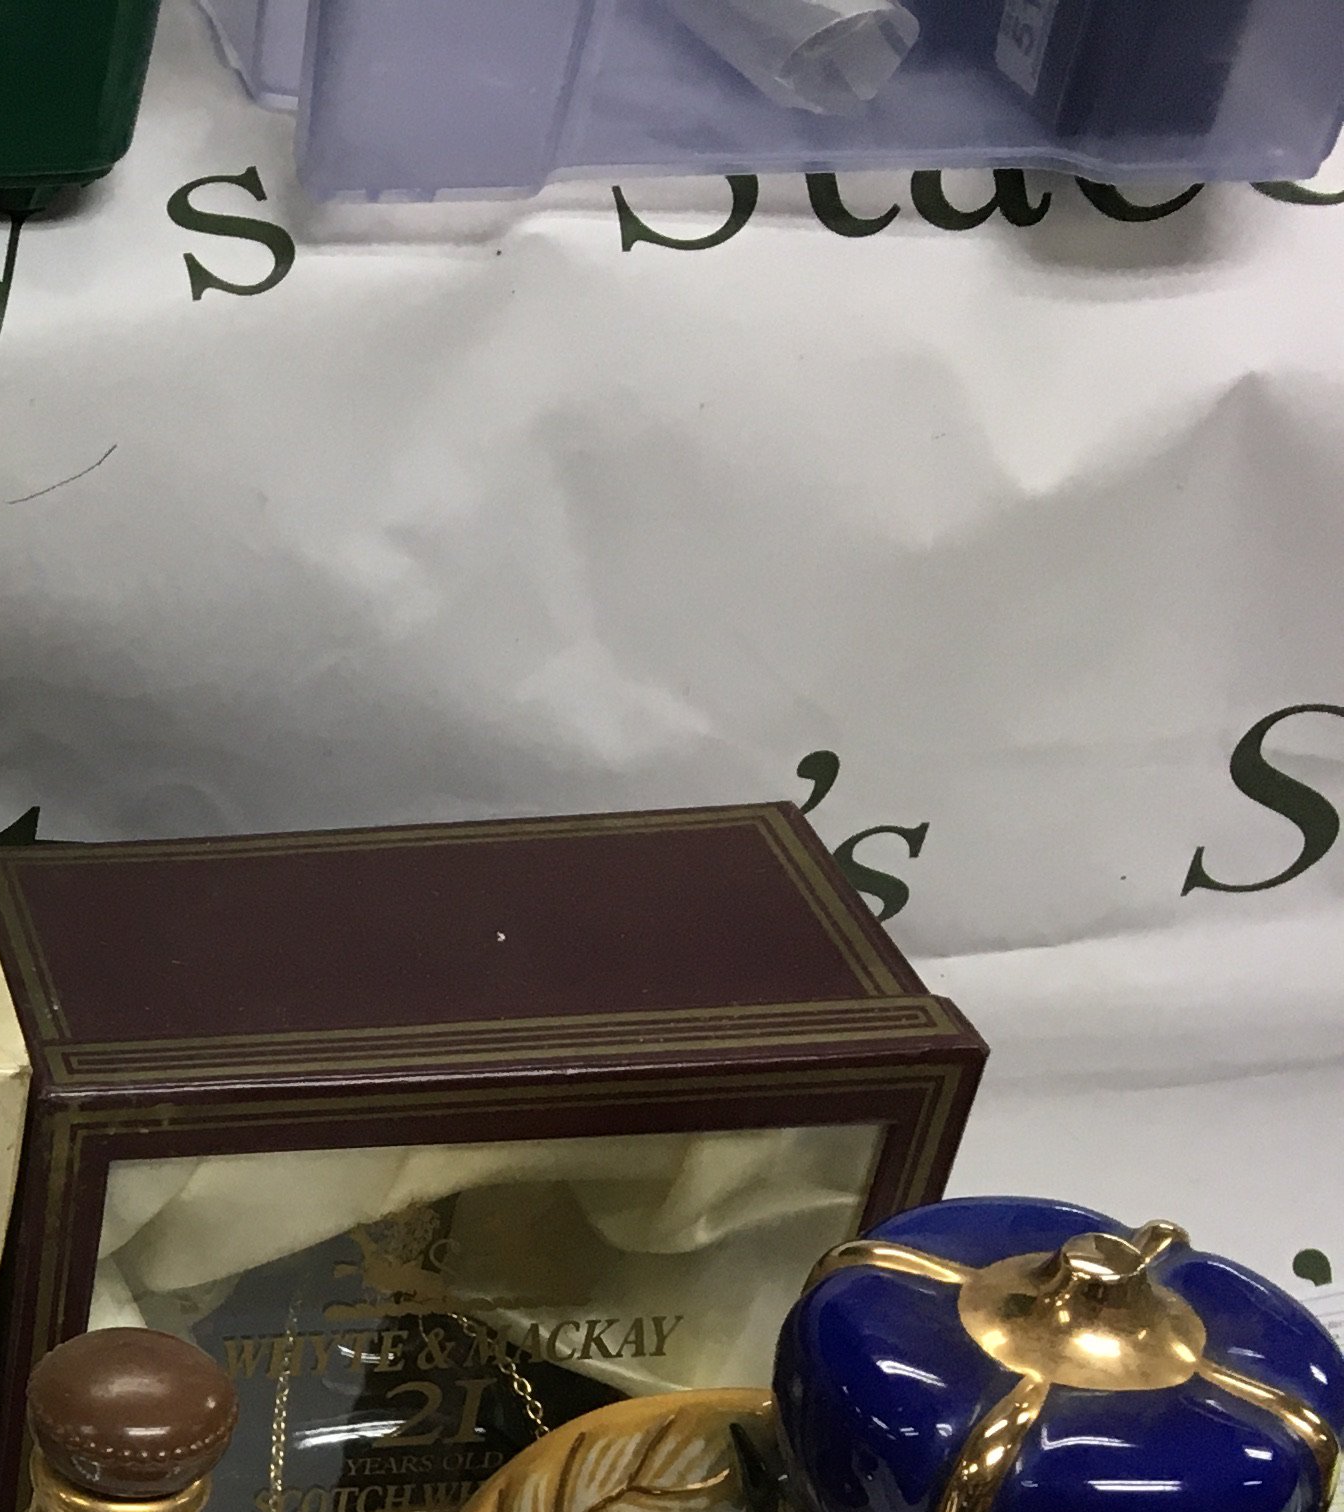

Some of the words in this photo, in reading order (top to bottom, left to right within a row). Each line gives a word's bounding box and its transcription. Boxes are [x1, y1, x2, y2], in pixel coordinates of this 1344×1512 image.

[223, 1330, 410, 1378] WHYTE
[417, 1328, 457, 1370] &
[463, 1314, 684, 1368] MACKAY
[345, 1455, 433, 1477] YEARS
[442, 1451, 505, 1470] OLD
